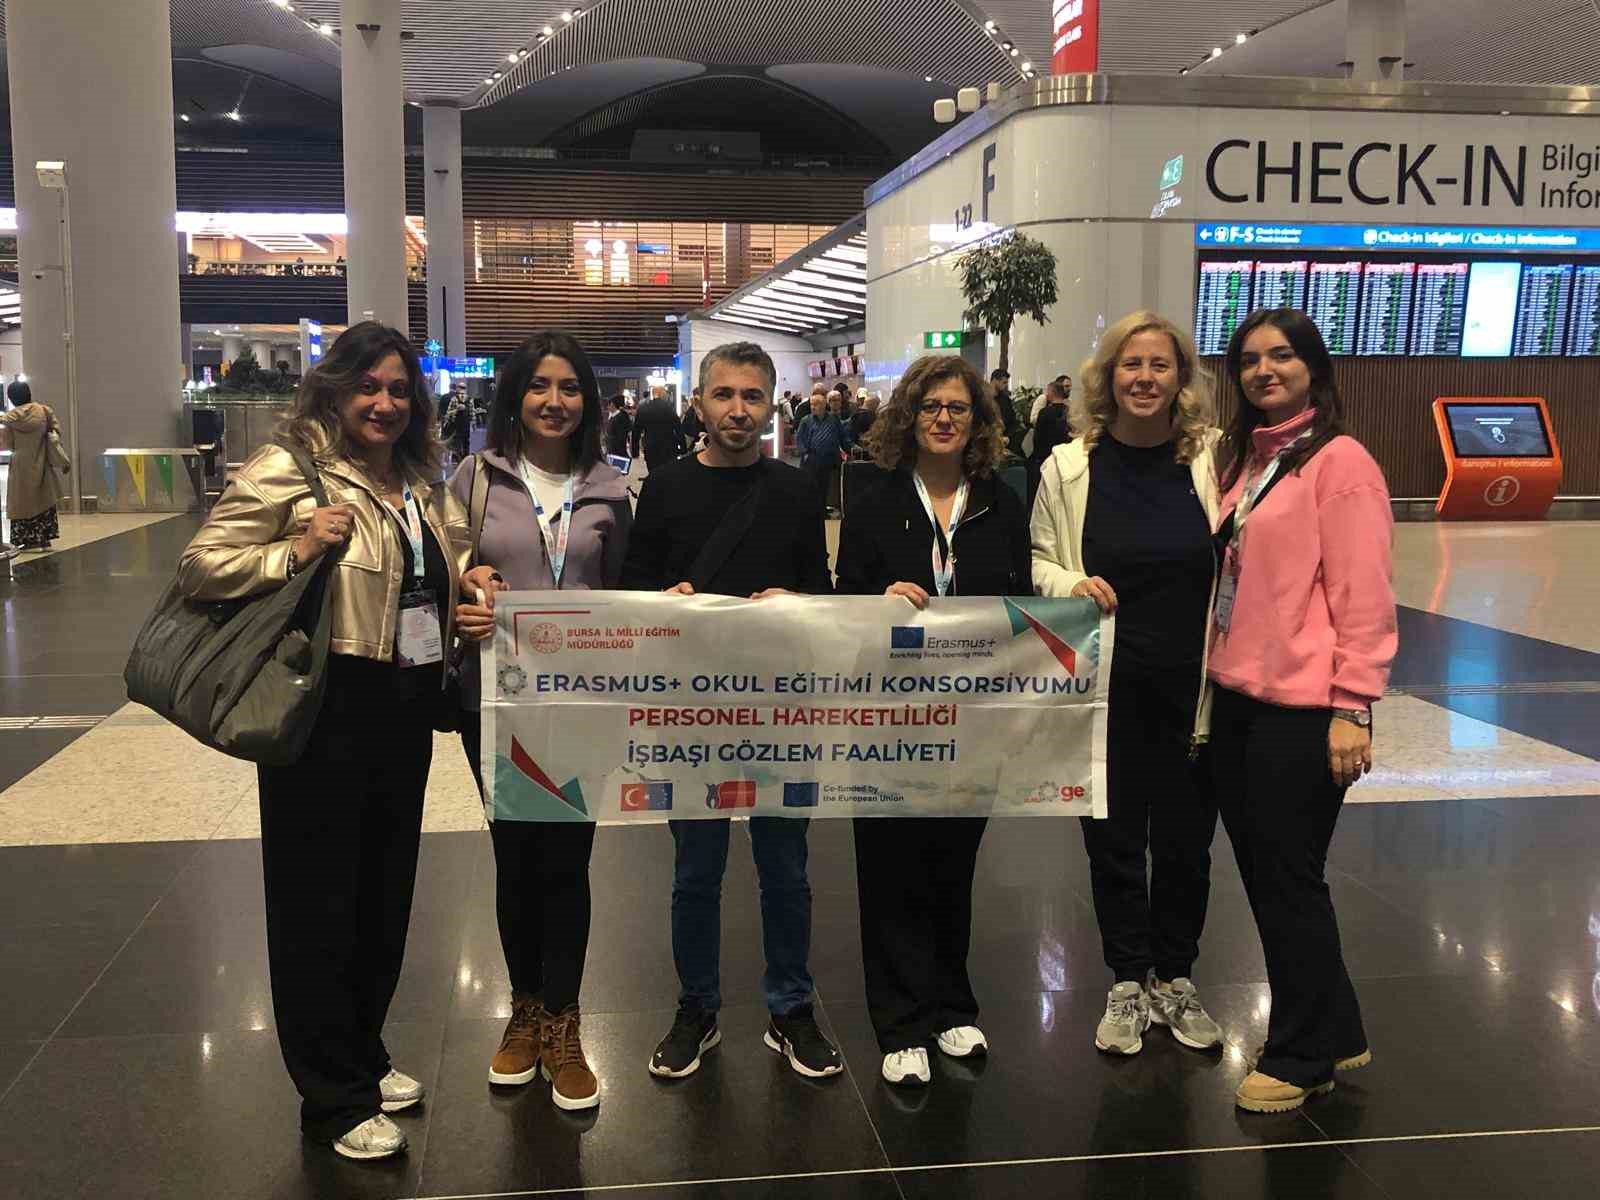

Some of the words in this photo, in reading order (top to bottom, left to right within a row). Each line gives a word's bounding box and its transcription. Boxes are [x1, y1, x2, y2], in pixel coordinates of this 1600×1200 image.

[1543, 144, 1600, 178] Bilgi
[983, 142, 996, 223] F
[1205, 138, 1527, 207] CHECK-IN
[567, 628, 601, 637] BURSA
[605, 627, 616, 637] İL
[616, 626, 643, 637] MİLLİ
[645, 626, 680, 637] EĞİTİM
[927, 636, 996, 649] Erasmus+
[567, 639, 634, 649] MÜDÜRLÜĞÜ
[536, 674, 682, 693] ERASMUS+
[692, 674, 764, 693] OKUL
[774, 672, 872, 693] EĞİTİMİ
[881, 672, 1090, 694] KONSORSİYUMU
[628, 708, 765, 727] PERSONEL
[772, 704, 957, 726] HAREKETLİLİĞİ
[628, 740, 710, 768] İŞBAŞI
[718, 740, 822, 762] GÖZLEM
[831, 739, 955, 762] FAALİYETİ
[880, 793, 904, 802] Union
